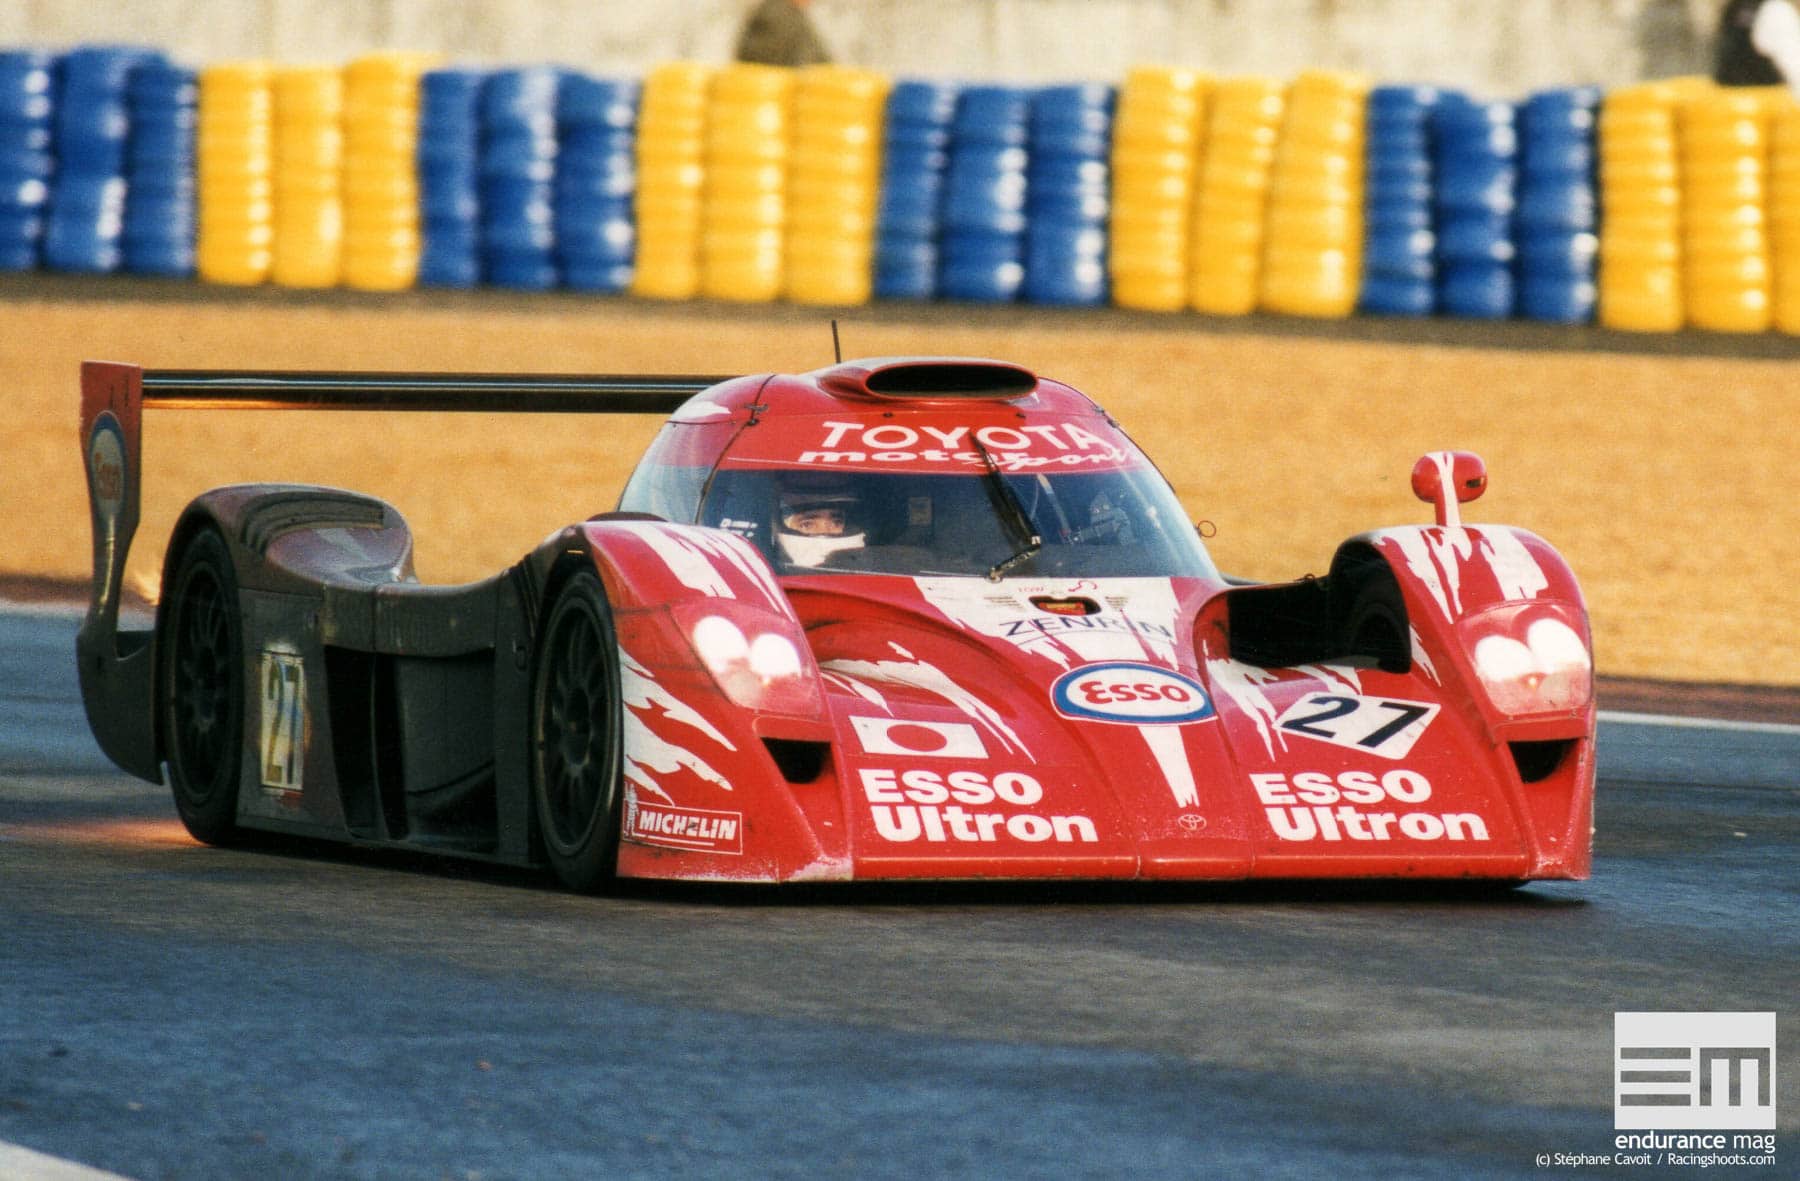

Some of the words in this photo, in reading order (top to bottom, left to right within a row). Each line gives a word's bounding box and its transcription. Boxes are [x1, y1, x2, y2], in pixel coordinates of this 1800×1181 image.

[821, 421, 1112, 450] TOYOTA
[1281, 696, 1430, 748] 27
[639, 810, 737, 840] MICHELIN
[870, 806, 1099, 842] Ultron
[1264, 806, 1490, 841] Ultron
